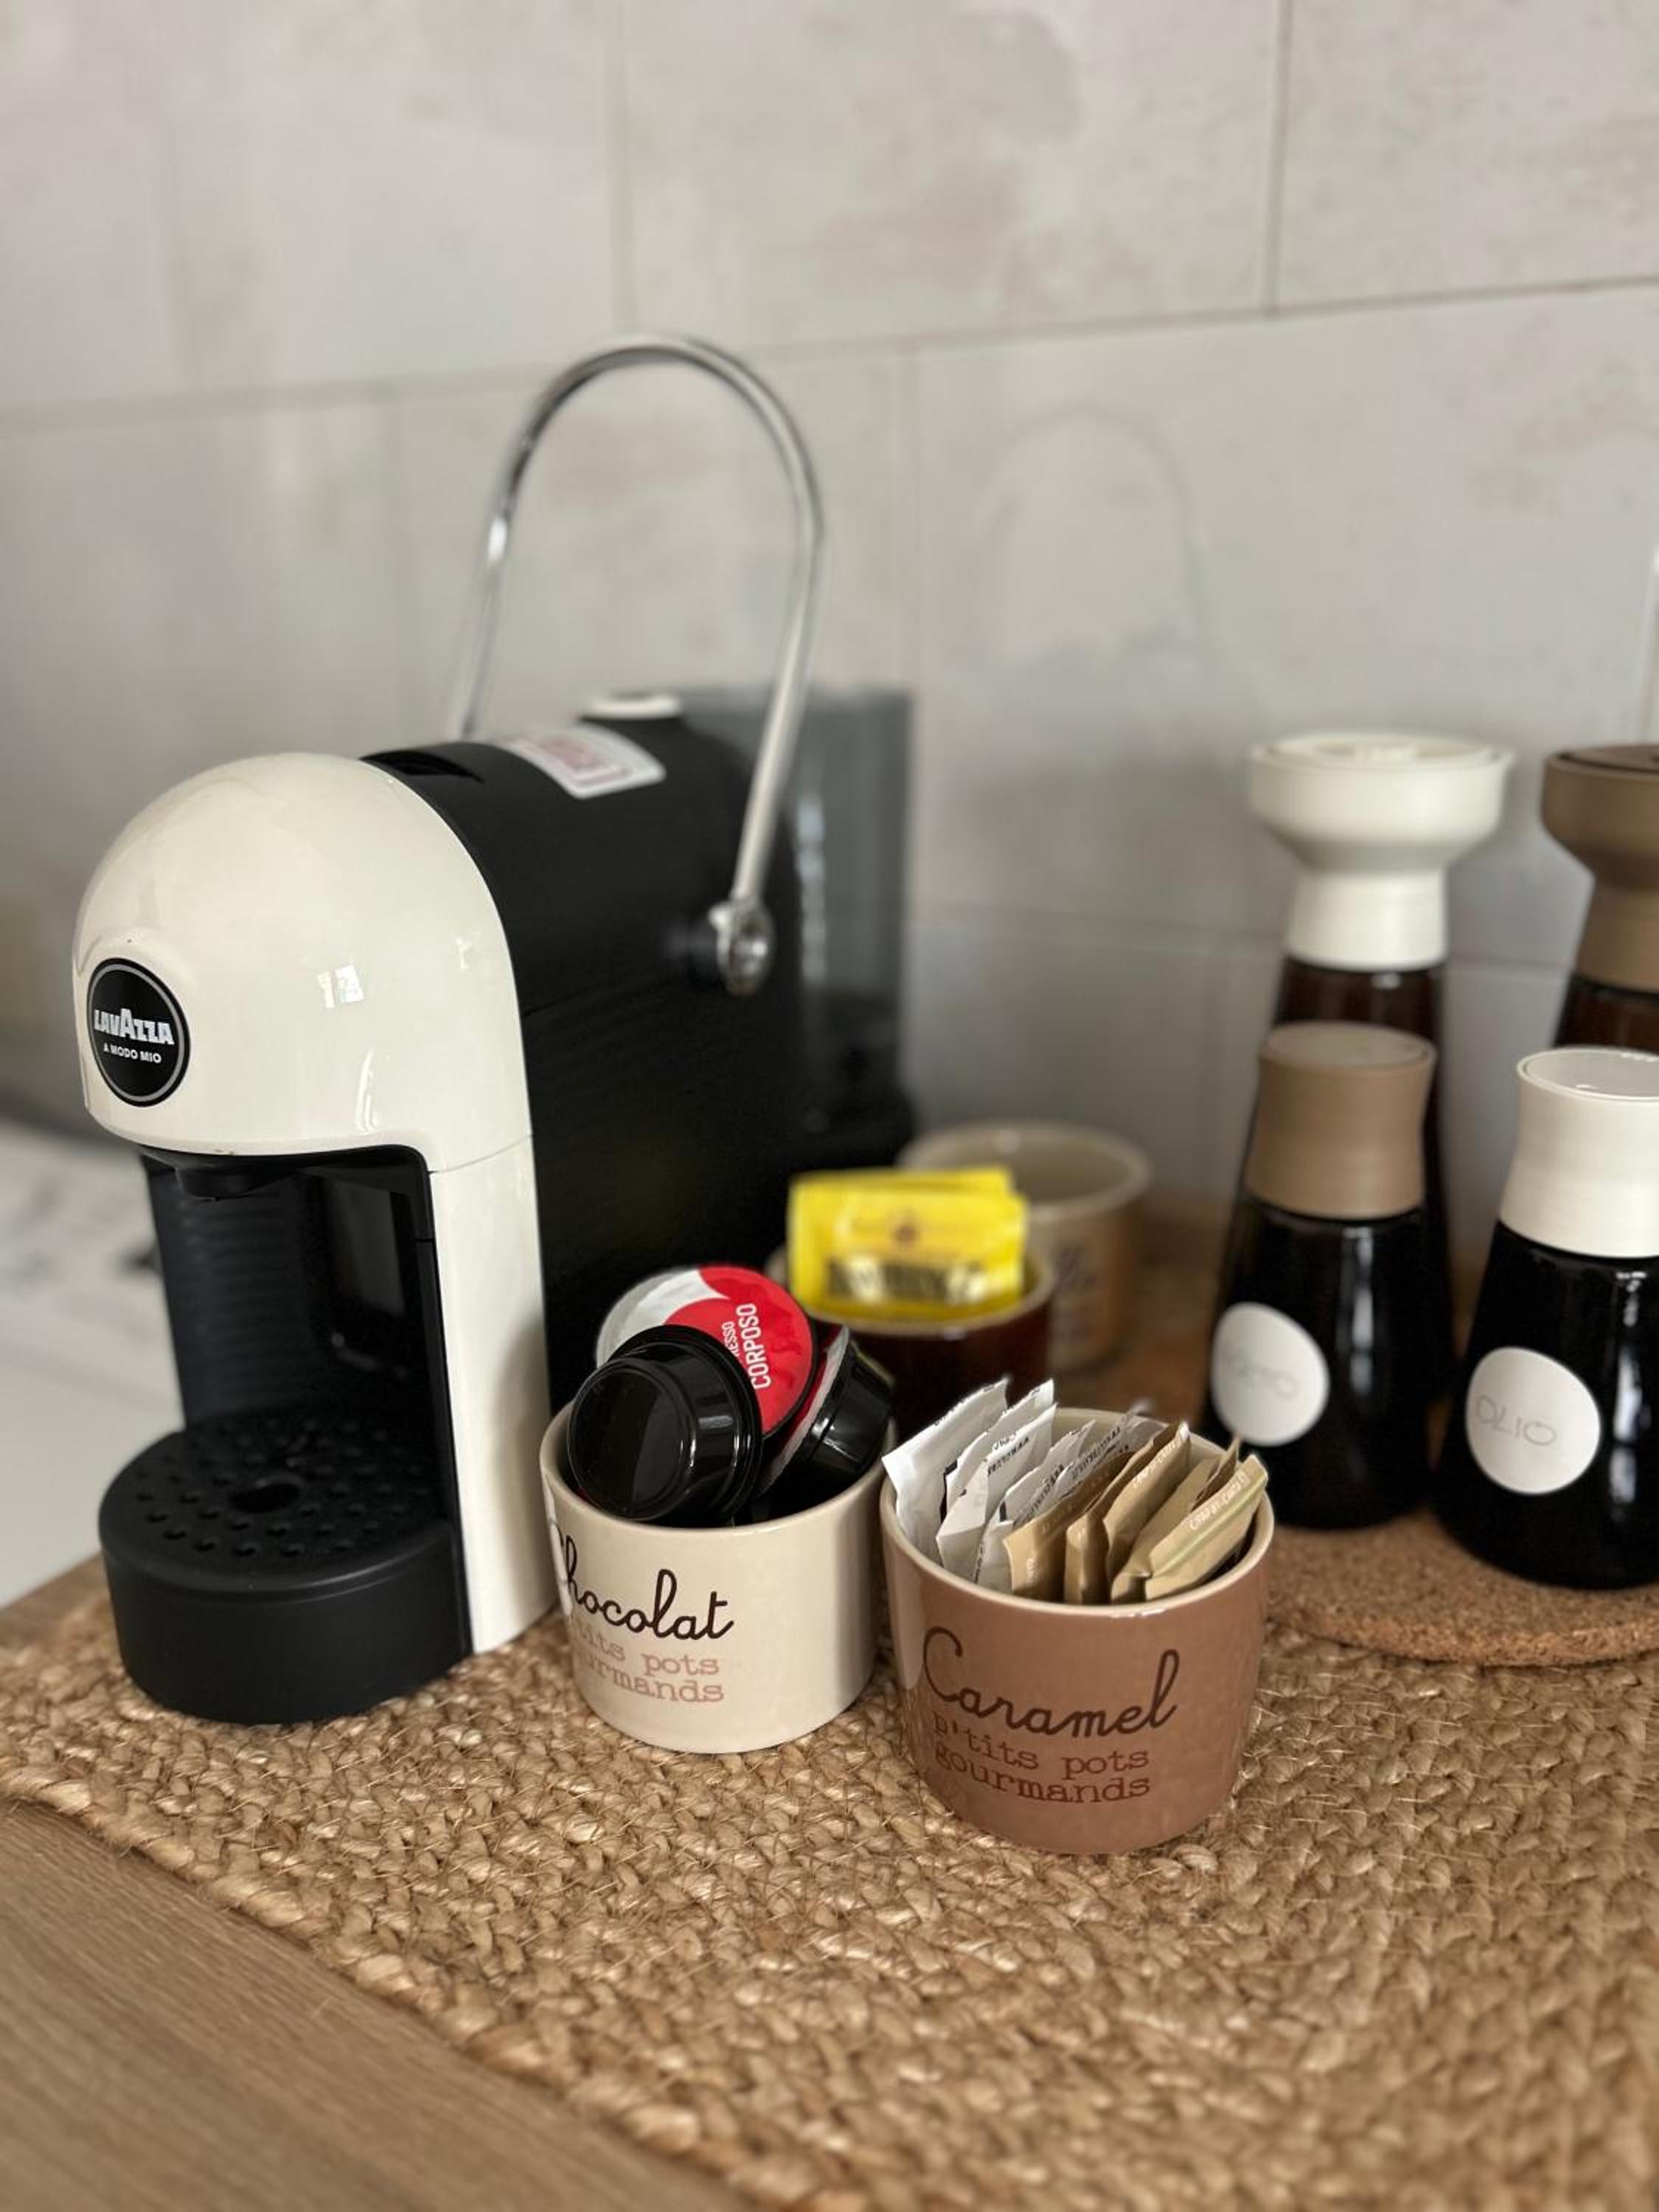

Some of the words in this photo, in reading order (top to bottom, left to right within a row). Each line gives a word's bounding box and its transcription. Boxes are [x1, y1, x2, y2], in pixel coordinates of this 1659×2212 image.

[94, 1008, 175, 1045] LAVAZZA
[104, 1043, 110, 1053] A
[110, 1044, 139, 1060] MODO
[140, 1051, 162, 1063] MIO
[736, 1303, 771, 1390] CORPOSO
[1475, 1394, 1557, 1447] OLIO
[640, 1653, 720, 1676] pots
[923, 1627, 1180, 1738] Caramel
[935, 1741, 1151, 1803] gourmands
[1062, 1750, 1150, 1781] pots
